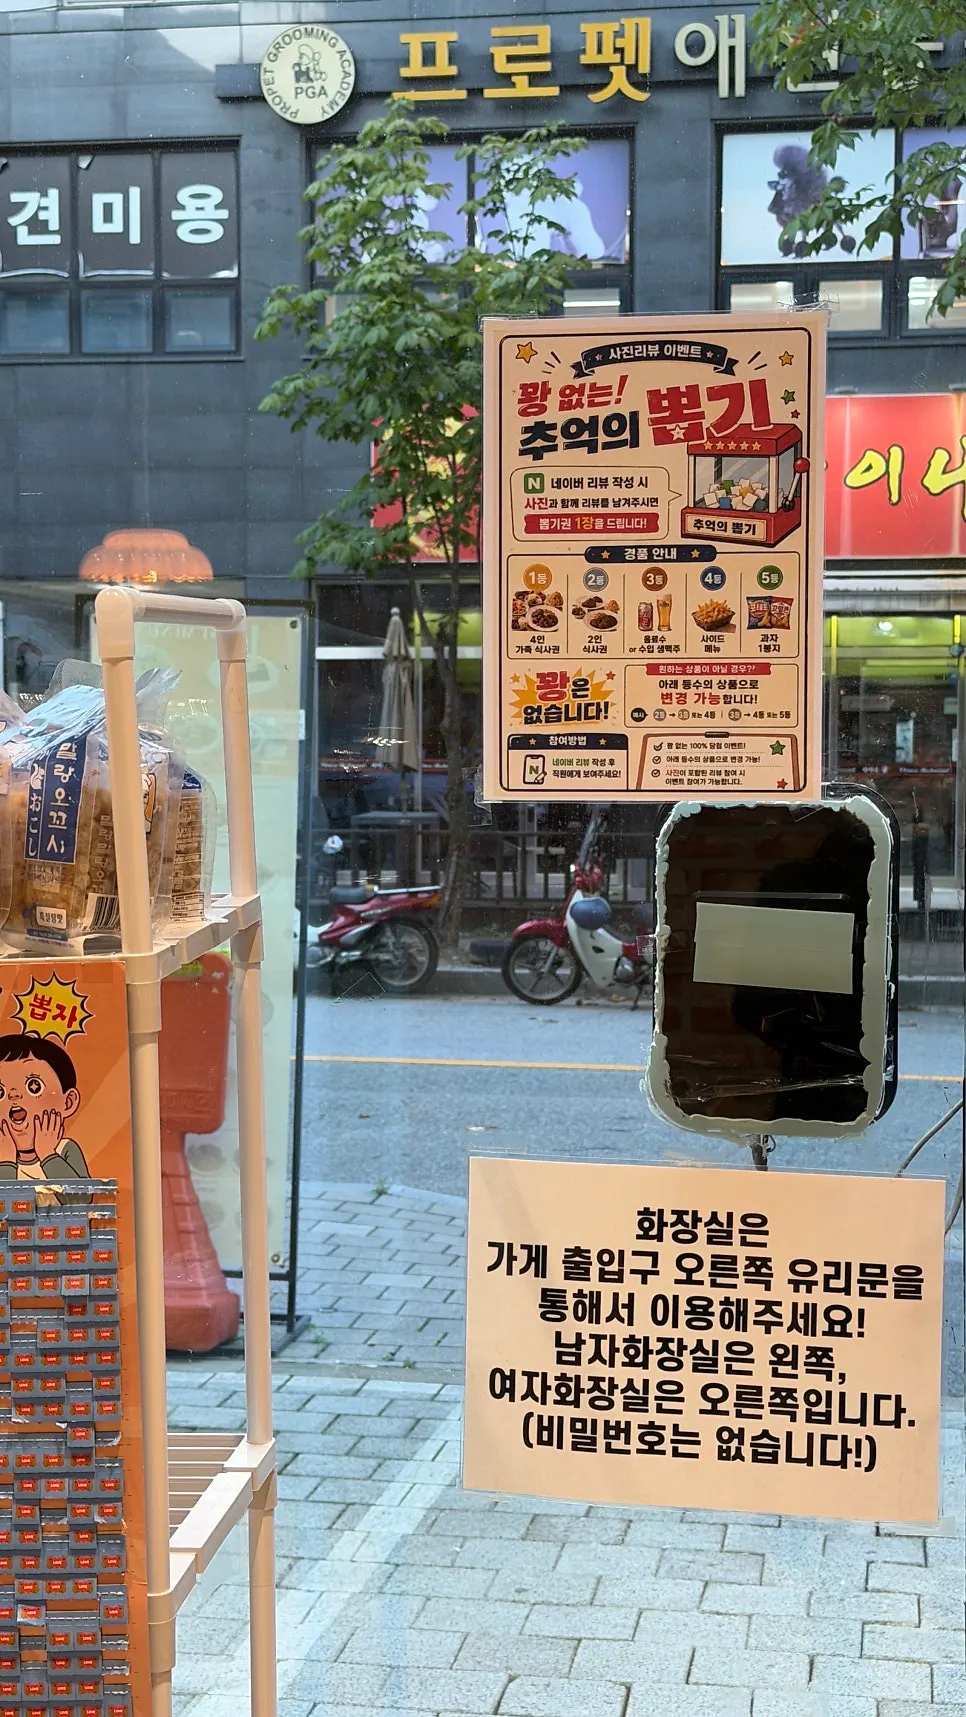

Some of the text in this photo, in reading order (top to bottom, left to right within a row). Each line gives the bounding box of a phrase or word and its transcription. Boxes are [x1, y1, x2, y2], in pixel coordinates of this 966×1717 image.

[263, 27, 352, 119] PROPET GROOMING ACADEMY
[294, 85, 329, 100] PGA
[609, 343, 702, 361] 사진리뷰 이벤트
[558, 374, 629, 412] 없는!
[518, 378, 771, 461] 추억의 뽑기
[527, 477, 541, 490] N
[551, 476, 649, 490] 네이버 리뷰 작성 시
[524, 497, 659, 511] 사진과 함께 리뷰를 남겨주시면
[539, 516, 647, 530] 뽑기권 1장을 드립니다!
[693, 519, 756, 536] 추억의 뽑기
[624, 547, 677, 561] 경품 안내
[529, 571, 548, 585] 1등
[587, 573, 605, 586] 2등
[646, 573, 664, 585] 3등
[704, 572, 722, 585] 4등
[761, 571, 779, 584] 5등
[529, 635, 545, 644] 4인
[587, 635, 602, 644] 2인
[643, 635, 667, 644] 음료수
[700, 634, 725, 643] 사이드
[760, 633, 778, 643] 과자
[515, 645, 560, 654] 가족 식사권
[583, 645, 608, 654] 식사권
[638, 645, 655, 654] 수입
[656, 645, 681, 654] 생맥주
[704, 645, 722, 653] 메뉴
[758, 644, 781, 653] 1봉지
[658, 665, 684, 674] 원하는
[685, 665, 710, 674] 상품이
[712, 665, 728, 674] 아닐
[536, 670, 590, 702] 꽝은
[658, 679, 760, 690] 아래 등수의 상품으로
[660, 692, 758, 706] 변경 가능합니다!
[523, 701, 610, 725] 없습니다!
[548, 735, 587, 746] 참여방법
[689, 742, 708, 750] 100%
[724, 742, 746, 750] 이벤트!
[552, 758, 616, 767] 네이버 리뷰 작성 후
[702, 755, 729, 763] 상품으로
[552, 770, 622, 779] 직원에게 보여주세요!
[665, 769, 687, 777] 사진이
[709, 769, 723, 777] 리뷰
[739, 769, 746, 777] 시
[665, 778, 685, 786] 이벤트
[28, 992, 78, 1029] 뽑자
[636, 1207, 770, 1248] 화장실은
[486, 1241, 925, 1301] 가게 출입구 오른쪽 유리문을
[538, 1287, 866, 1339] 통해서 이용해주세요!
[554, 1331, 848, 1386] 남자화장실은 왼쪽,
[488, 1367, 917, 1430] 여자화장실은 오른쪽입니다.
[522, 1410, 878, 1473] (비밀번호는 없습니다!)
